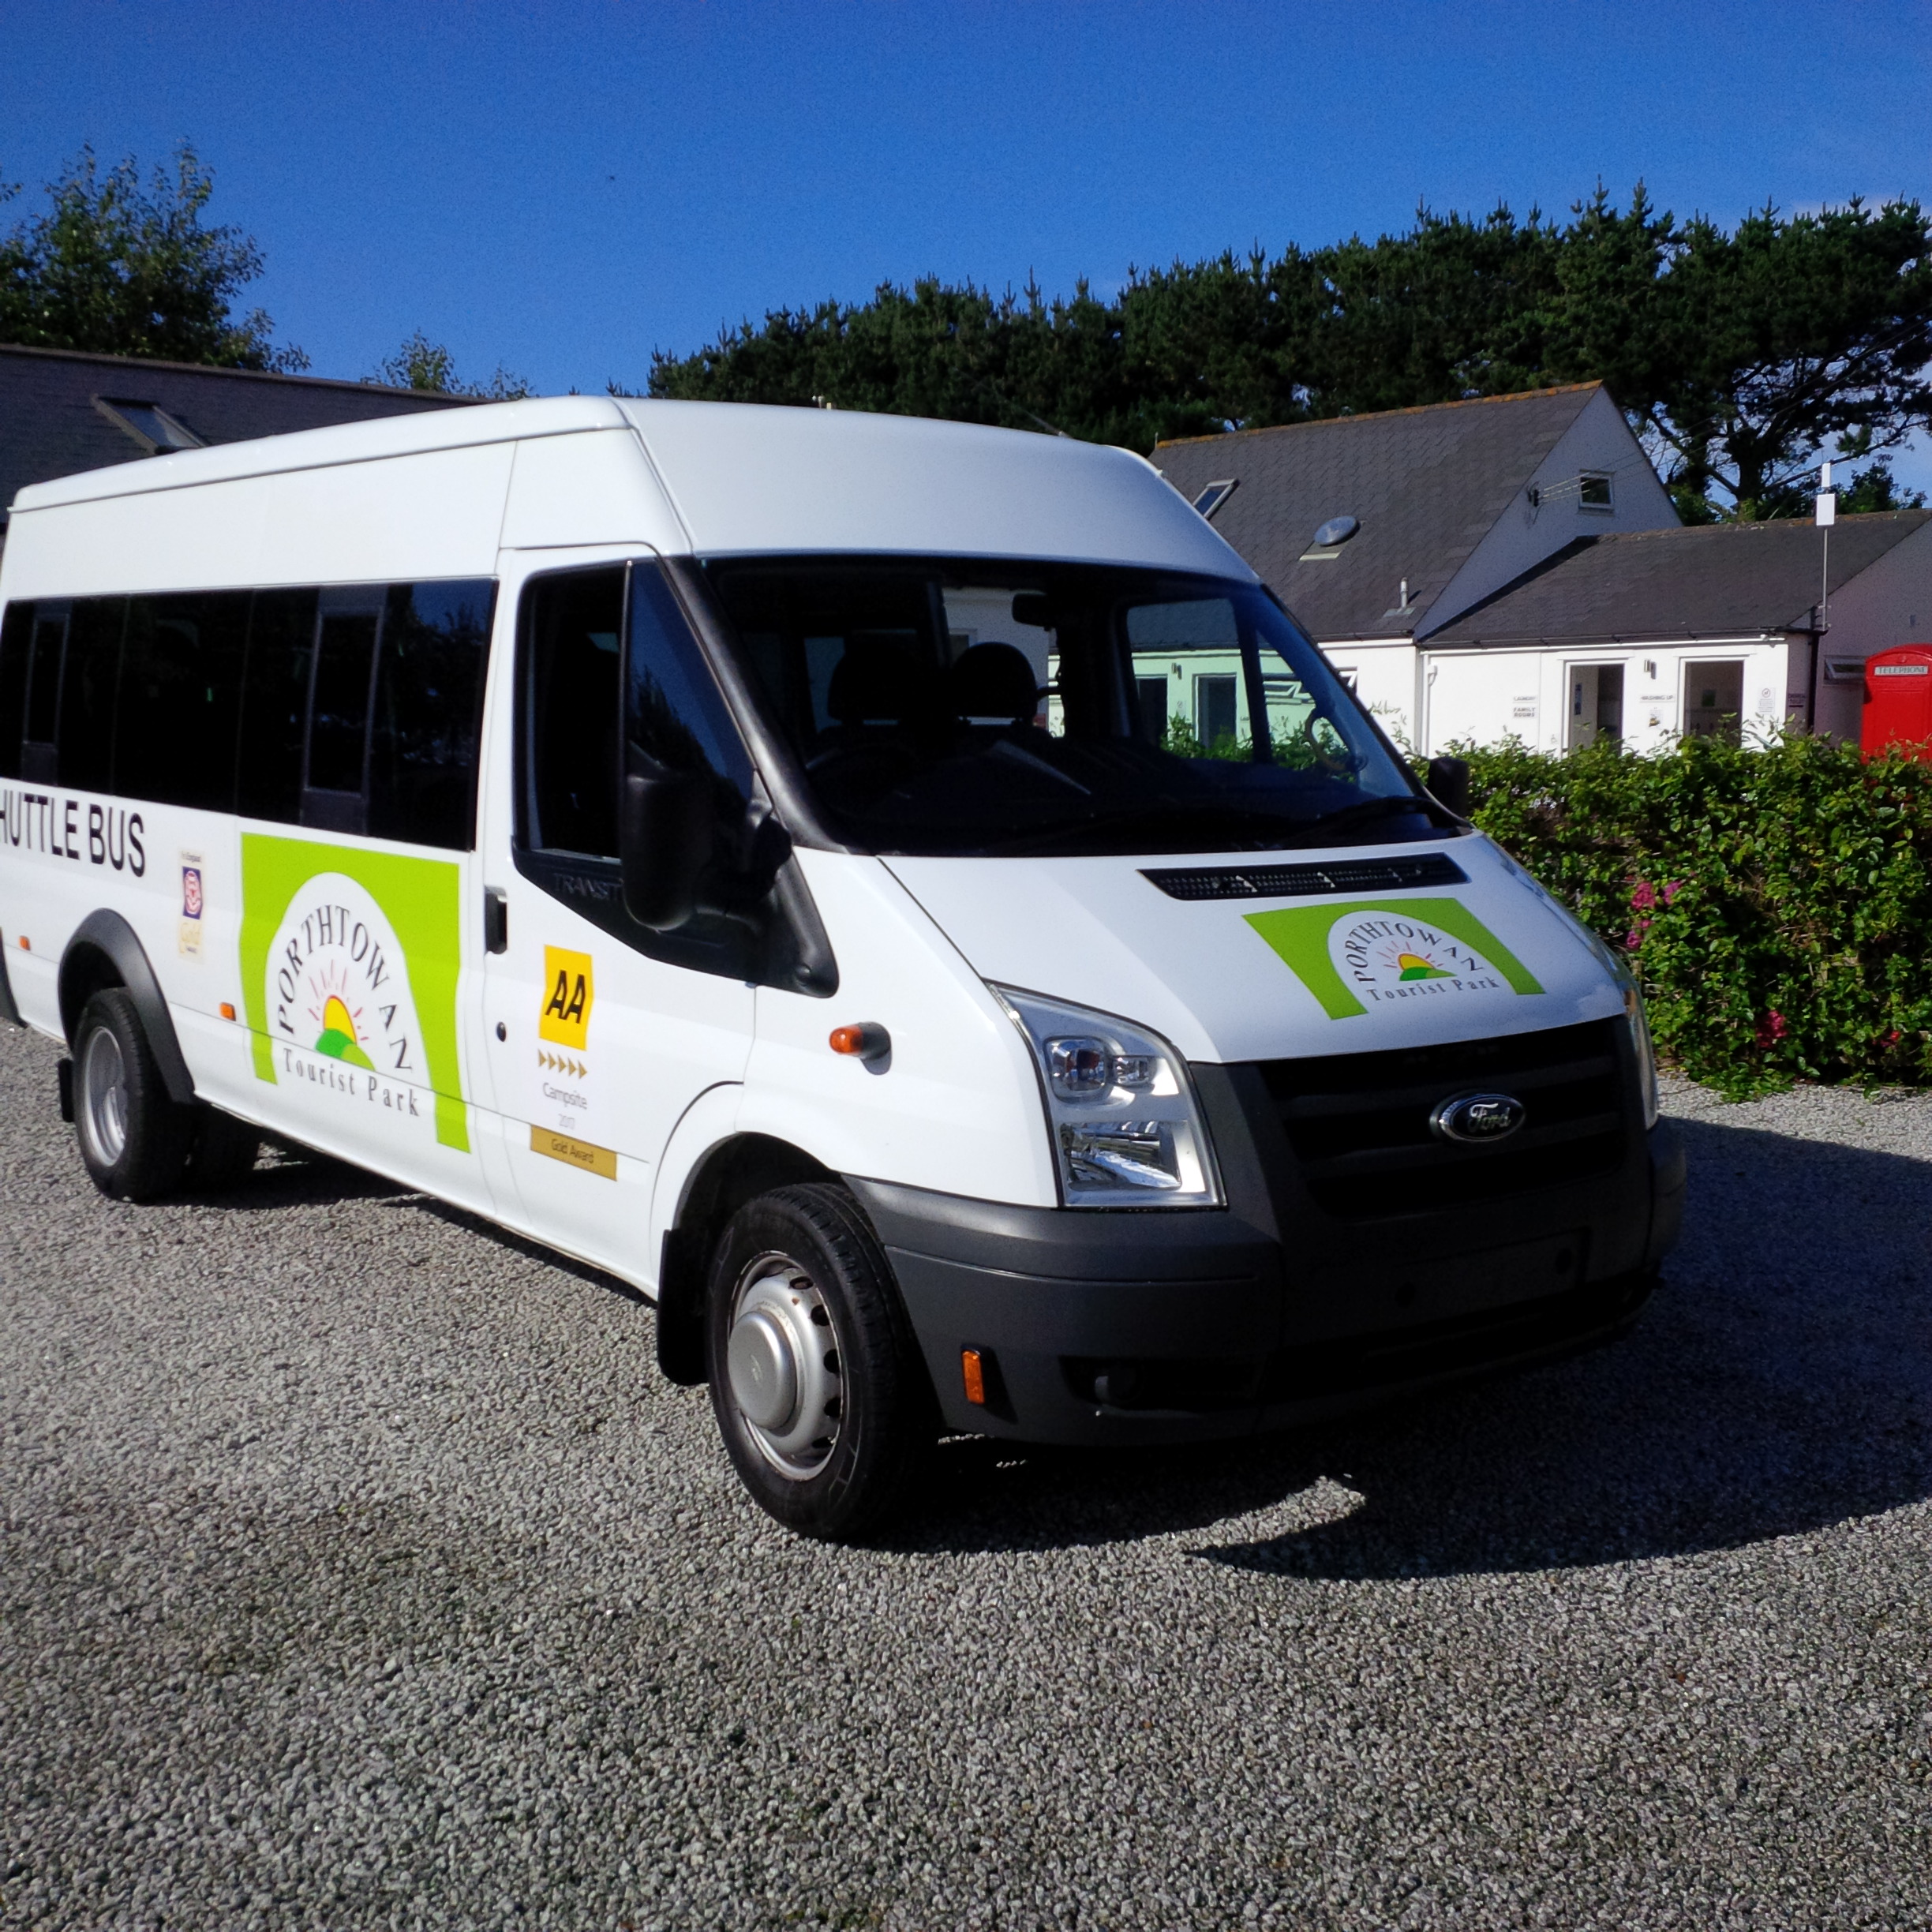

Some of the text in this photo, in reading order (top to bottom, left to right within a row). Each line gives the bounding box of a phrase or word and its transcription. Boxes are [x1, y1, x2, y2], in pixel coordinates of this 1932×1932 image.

[1877, 666, 1926, 675] TELEPHONE
[88, 803, 145, 878] BUS
[1345, 920, 1485, 983] PORTHTOWAN
[278, 904, 413, 1070] PORTHTOWAN
[545, 969, 586, 1024] AA
[1366, 976, 1500, 1001] Tourist Park
[283, 1047, 420, 1117] Tourist Park
[542, 1082, 587, 1110] Campsite
[1467, 1103, 1511, 1132] Ford
[551, 1138, 594, 1164] Gold Award
